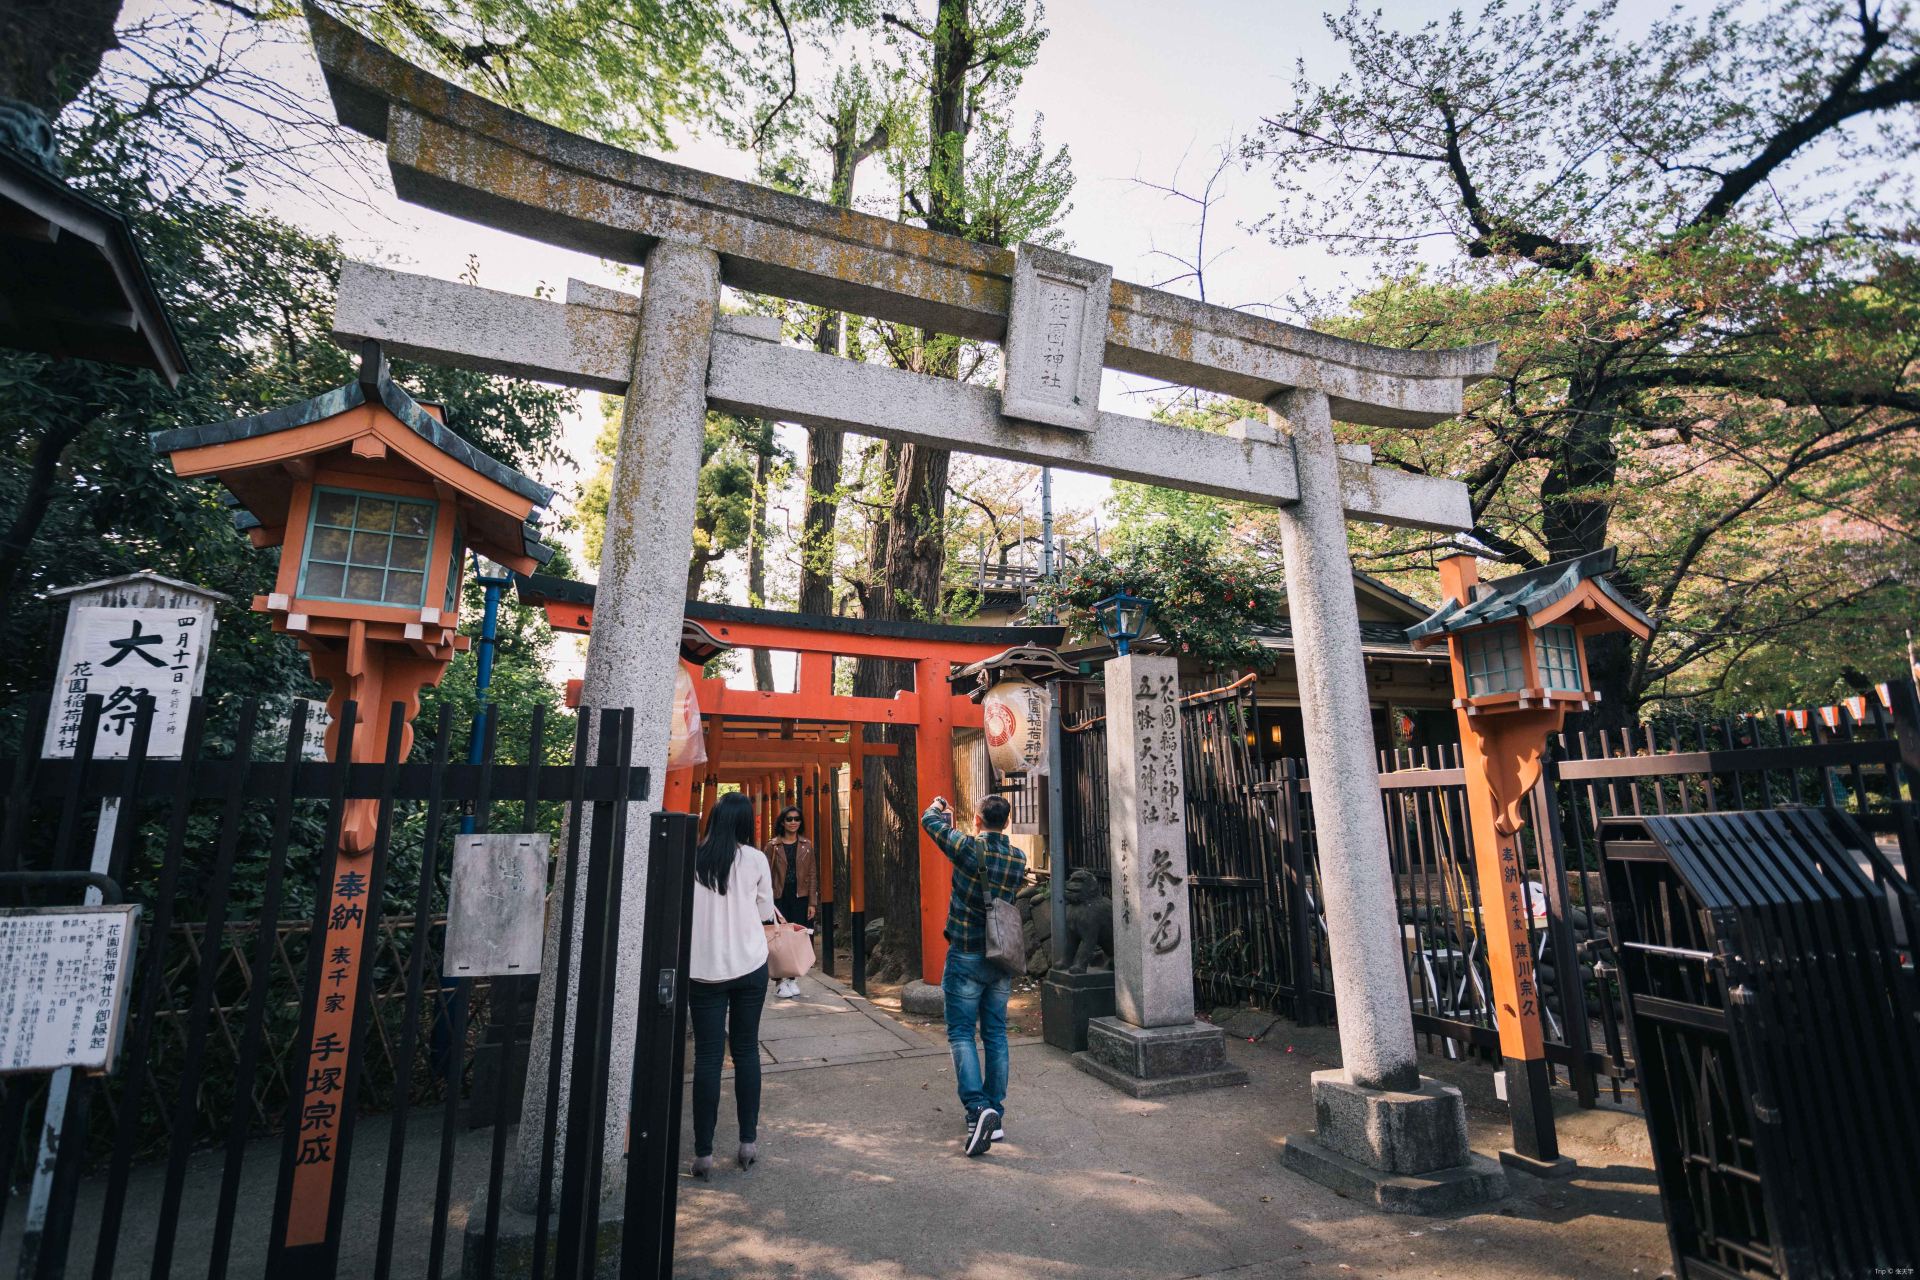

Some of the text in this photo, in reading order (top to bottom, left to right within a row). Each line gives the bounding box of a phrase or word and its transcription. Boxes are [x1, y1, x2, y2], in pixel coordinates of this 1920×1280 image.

[100, 619, 169, 736] 大祭
[169, 616, 196, 683] 四月十一日
[57, 661, 93, 751] 花園稲荷神社
[1502, 847, 1518, 883] 奉納
[297, 871, 366, 1166] 奉納 表千家 手塚宗成
